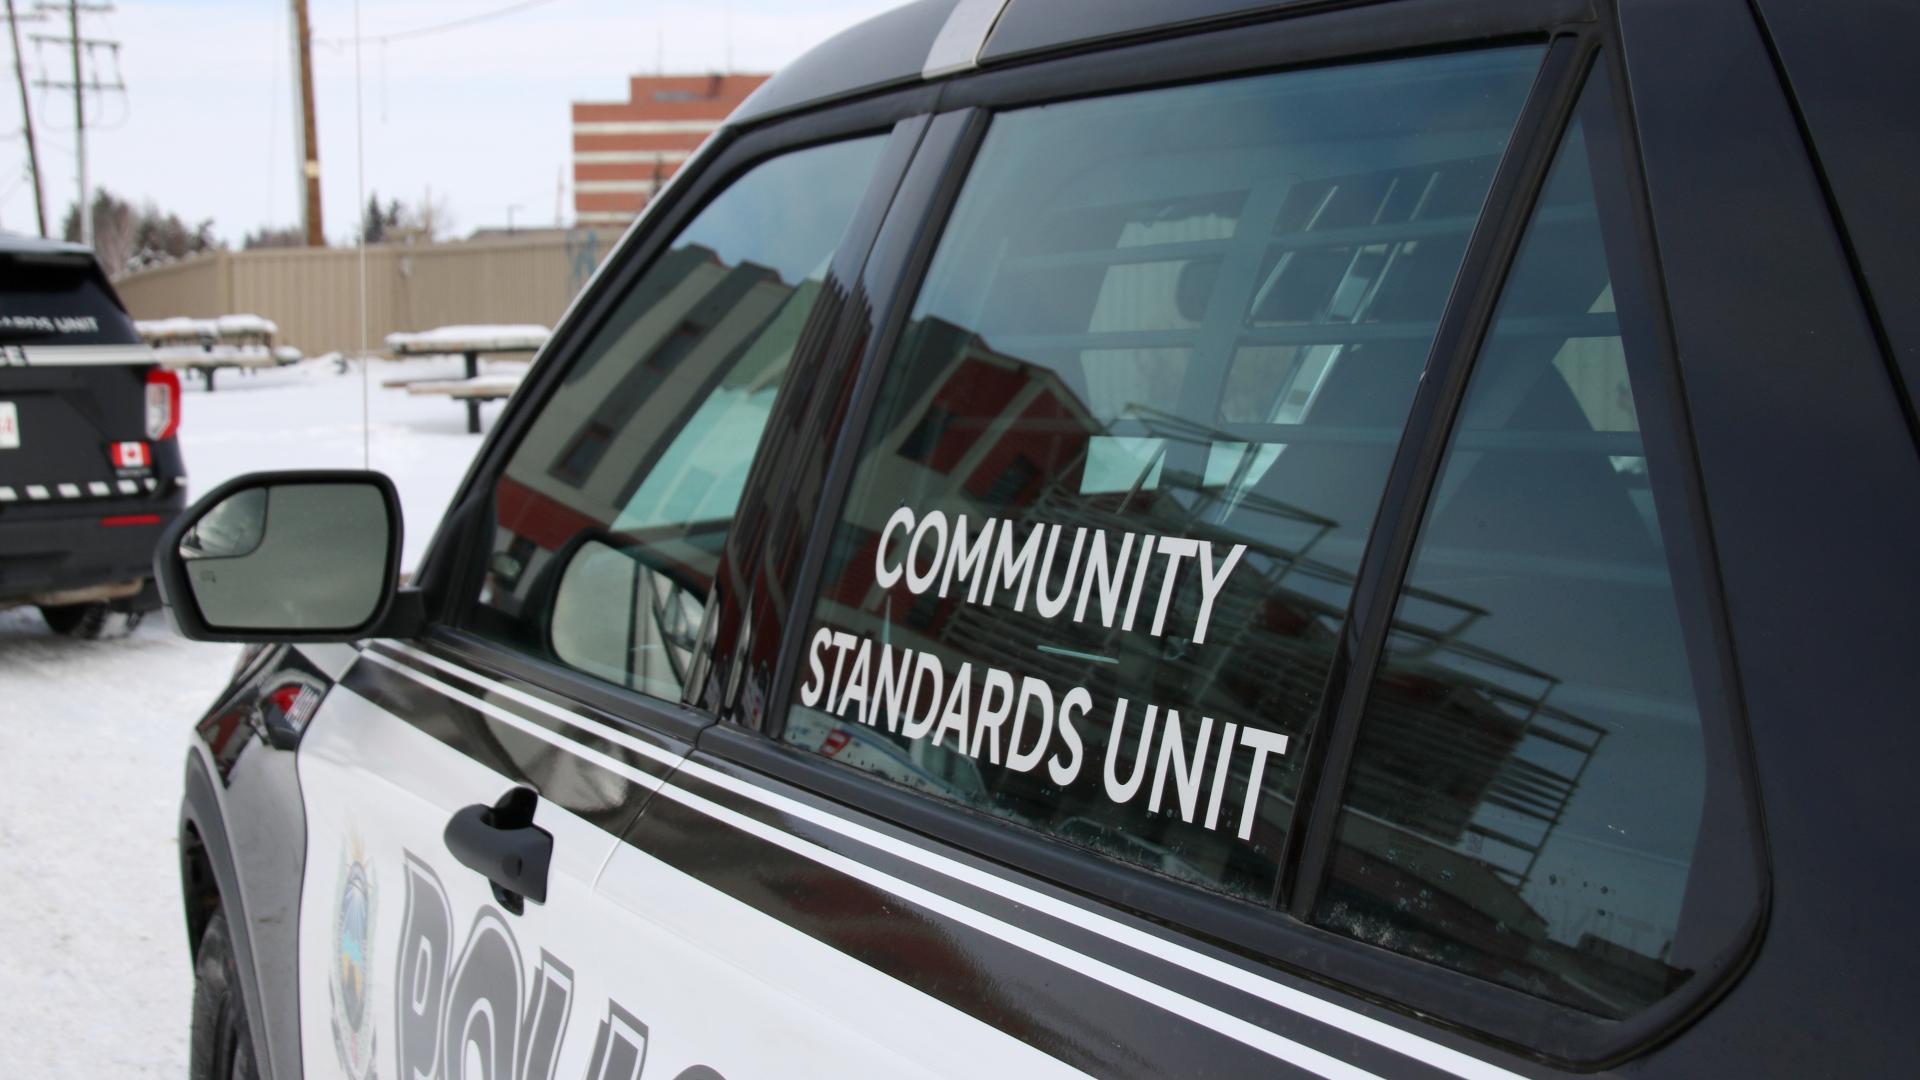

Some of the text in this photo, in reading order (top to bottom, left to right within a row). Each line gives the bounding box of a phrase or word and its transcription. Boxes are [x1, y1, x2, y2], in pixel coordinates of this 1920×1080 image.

[54, 316, 98, 333] UNIT
[875, 507, 1247, 644] COMMUNITY
[801, 627, 1289, 841] STANDARDS UNIT
